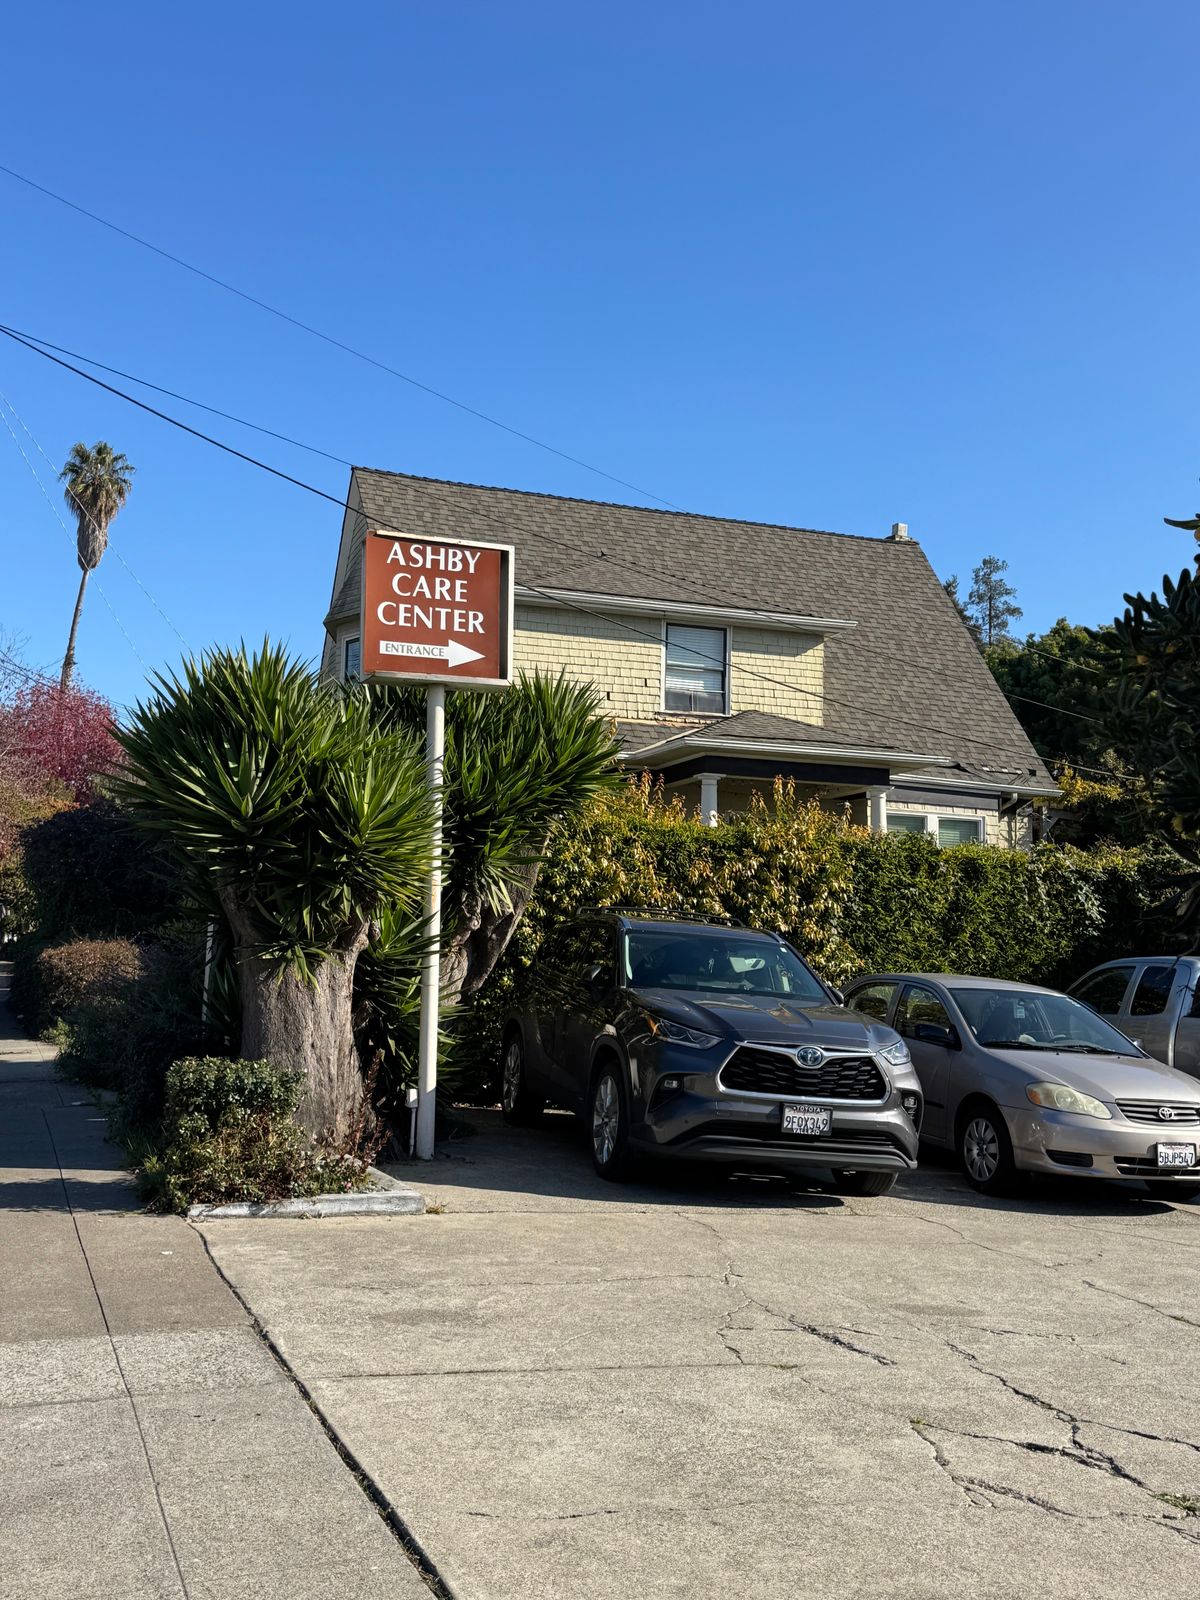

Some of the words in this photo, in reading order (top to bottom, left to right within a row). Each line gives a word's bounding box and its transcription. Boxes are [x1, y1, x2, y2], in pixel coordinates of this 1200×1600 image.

[386, 541, 481, 574] ASHBY
[391, 572, 468, 603] CARE
[376, 601, 486, 634] CENTER
[385, 642, 445, 657] ENTRANCE
[796, 1105, 821, 1113] TOYOTA
[1159, 1151, 1194, 1164] 5BJP547
